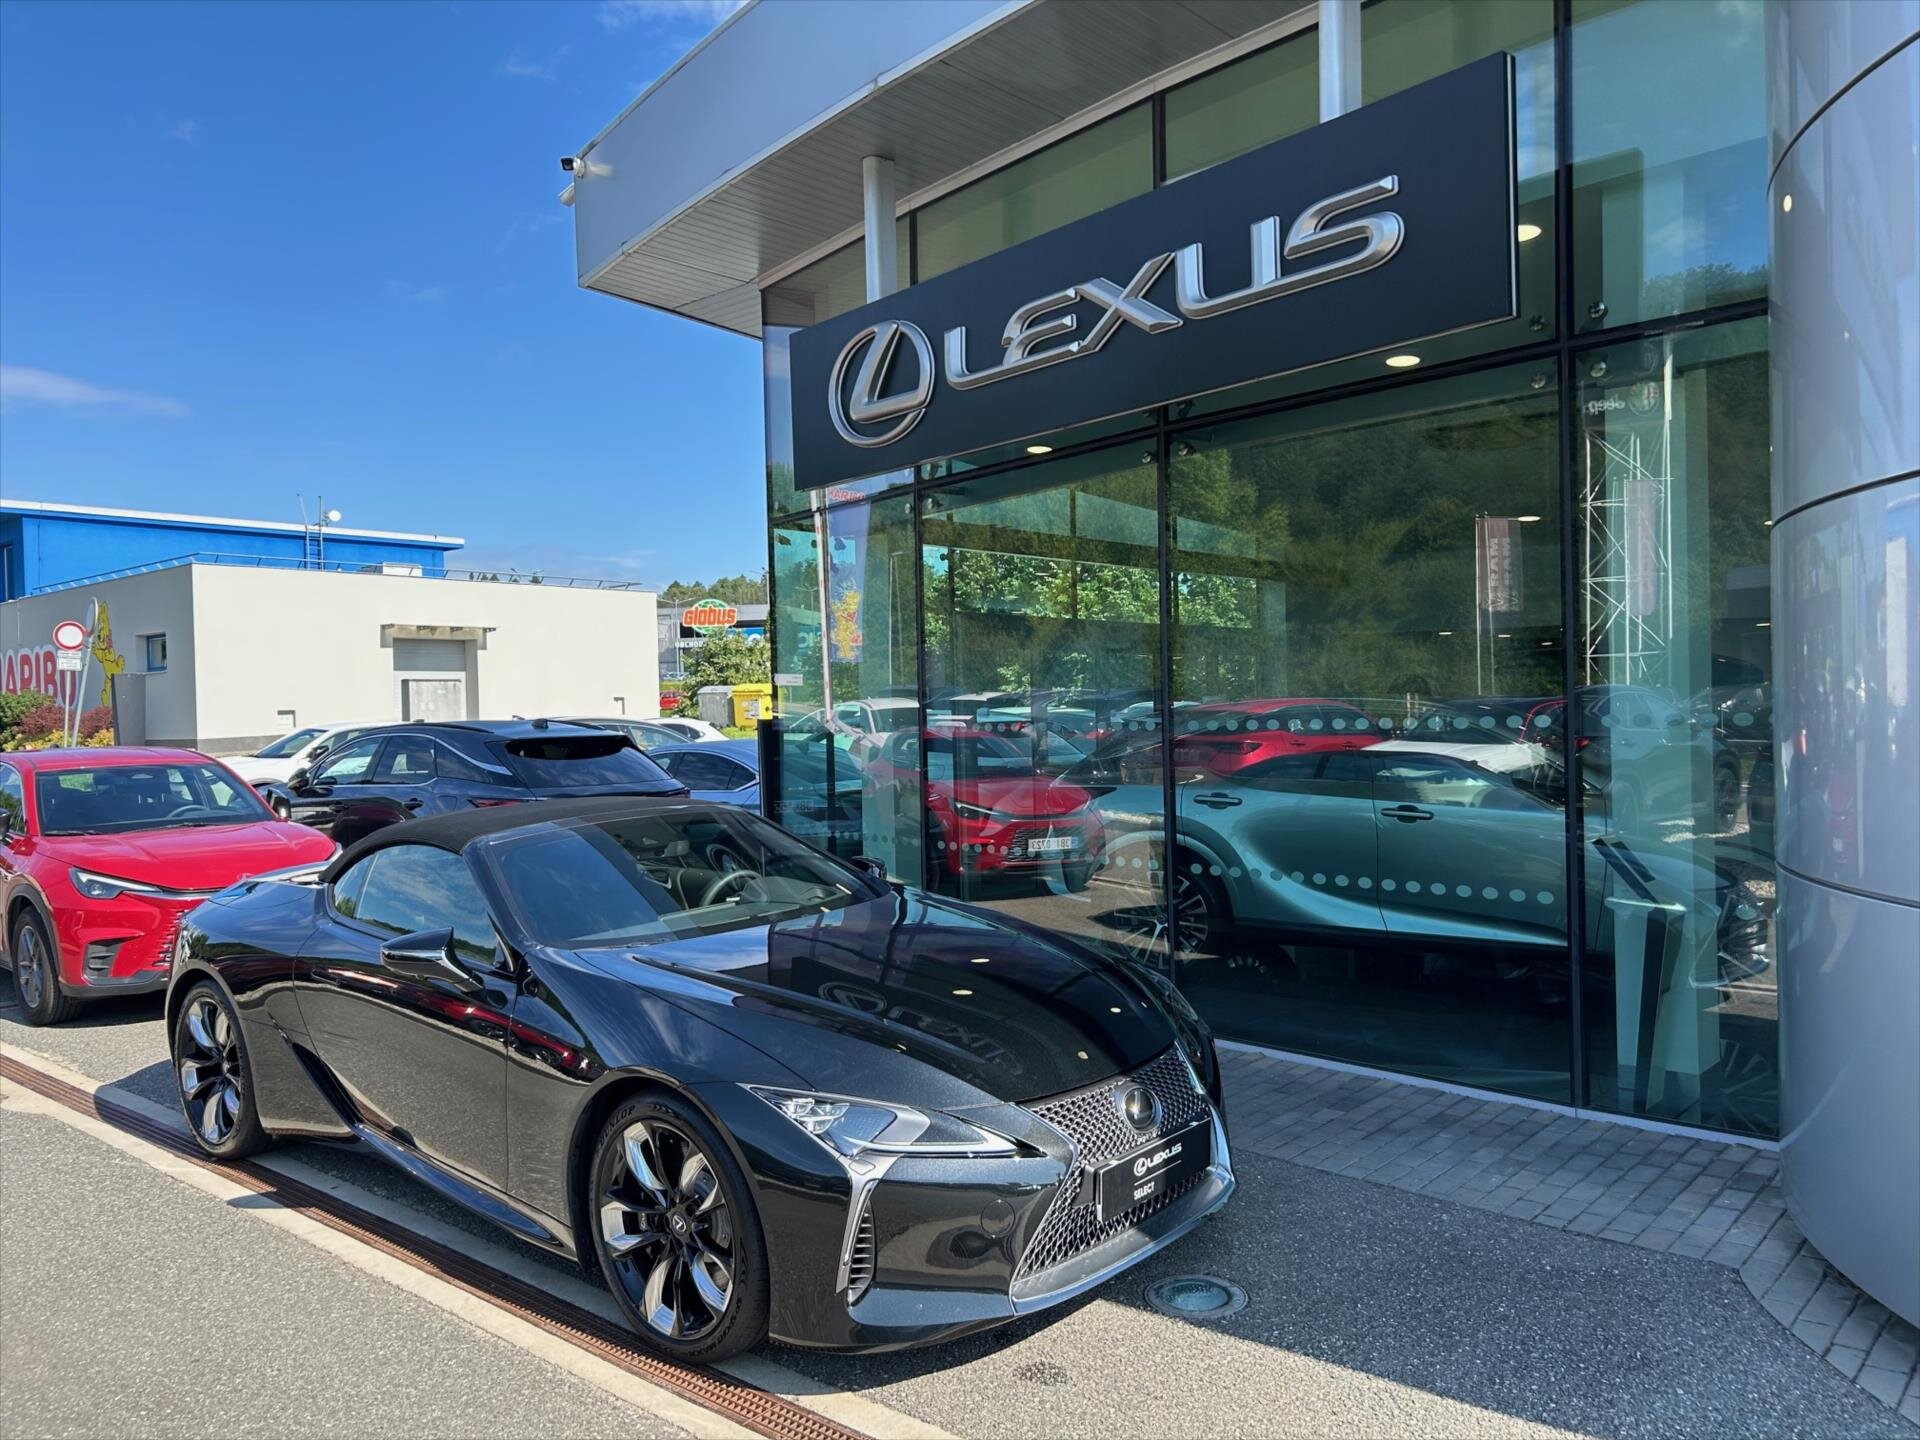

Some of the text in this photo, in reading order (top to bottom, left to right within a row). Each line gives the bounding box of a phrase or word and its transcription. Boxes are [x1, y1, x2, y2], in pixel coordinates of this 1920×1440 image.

[943, 174, 1405, 391] LEXUS
[0, 650, 77, 707] ARIBO
[1147, 1143, 1182, 1167] LEXUS
[1134, 1182, 1155, 1200] SELECT
